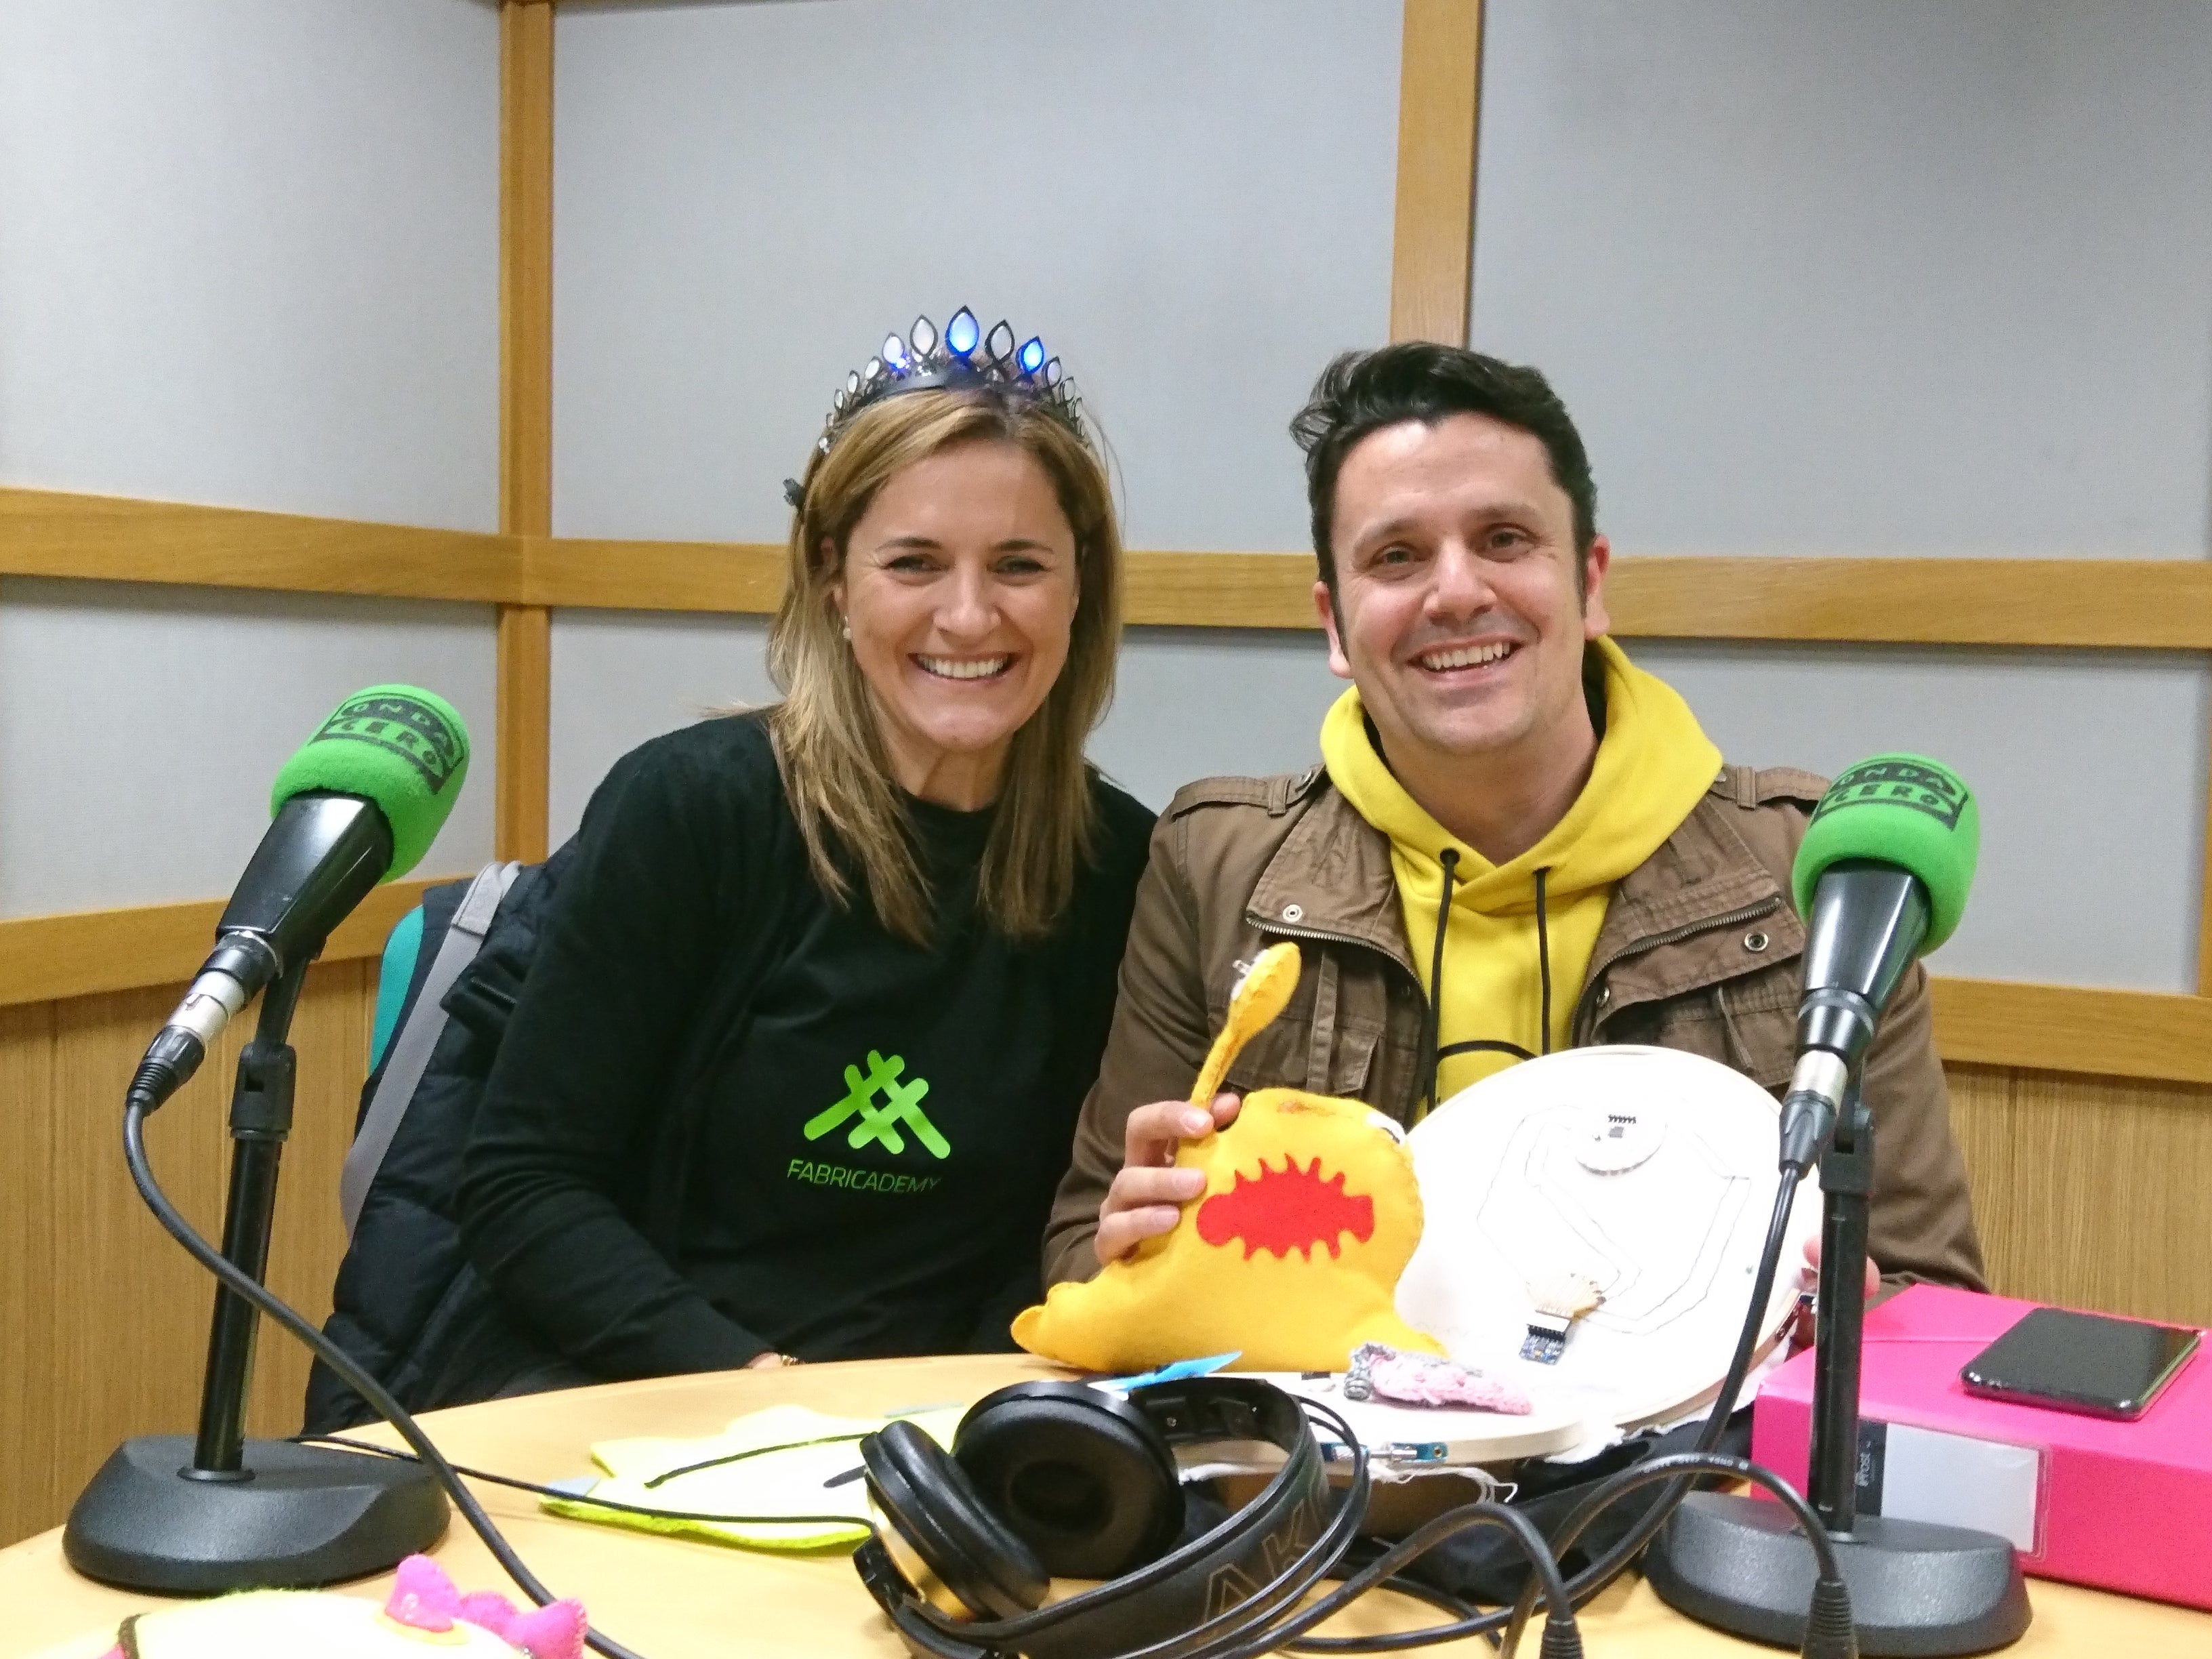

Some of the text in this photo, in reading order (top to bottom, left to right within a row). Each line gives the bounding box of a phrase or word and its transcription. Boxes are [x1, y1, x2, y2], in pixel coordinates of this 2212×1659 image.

[340, 719, 439, 766] CERO
[1832, 783, 1940, 806] CERO
[786, 1159, 942, 1193] FABRICADEMY
